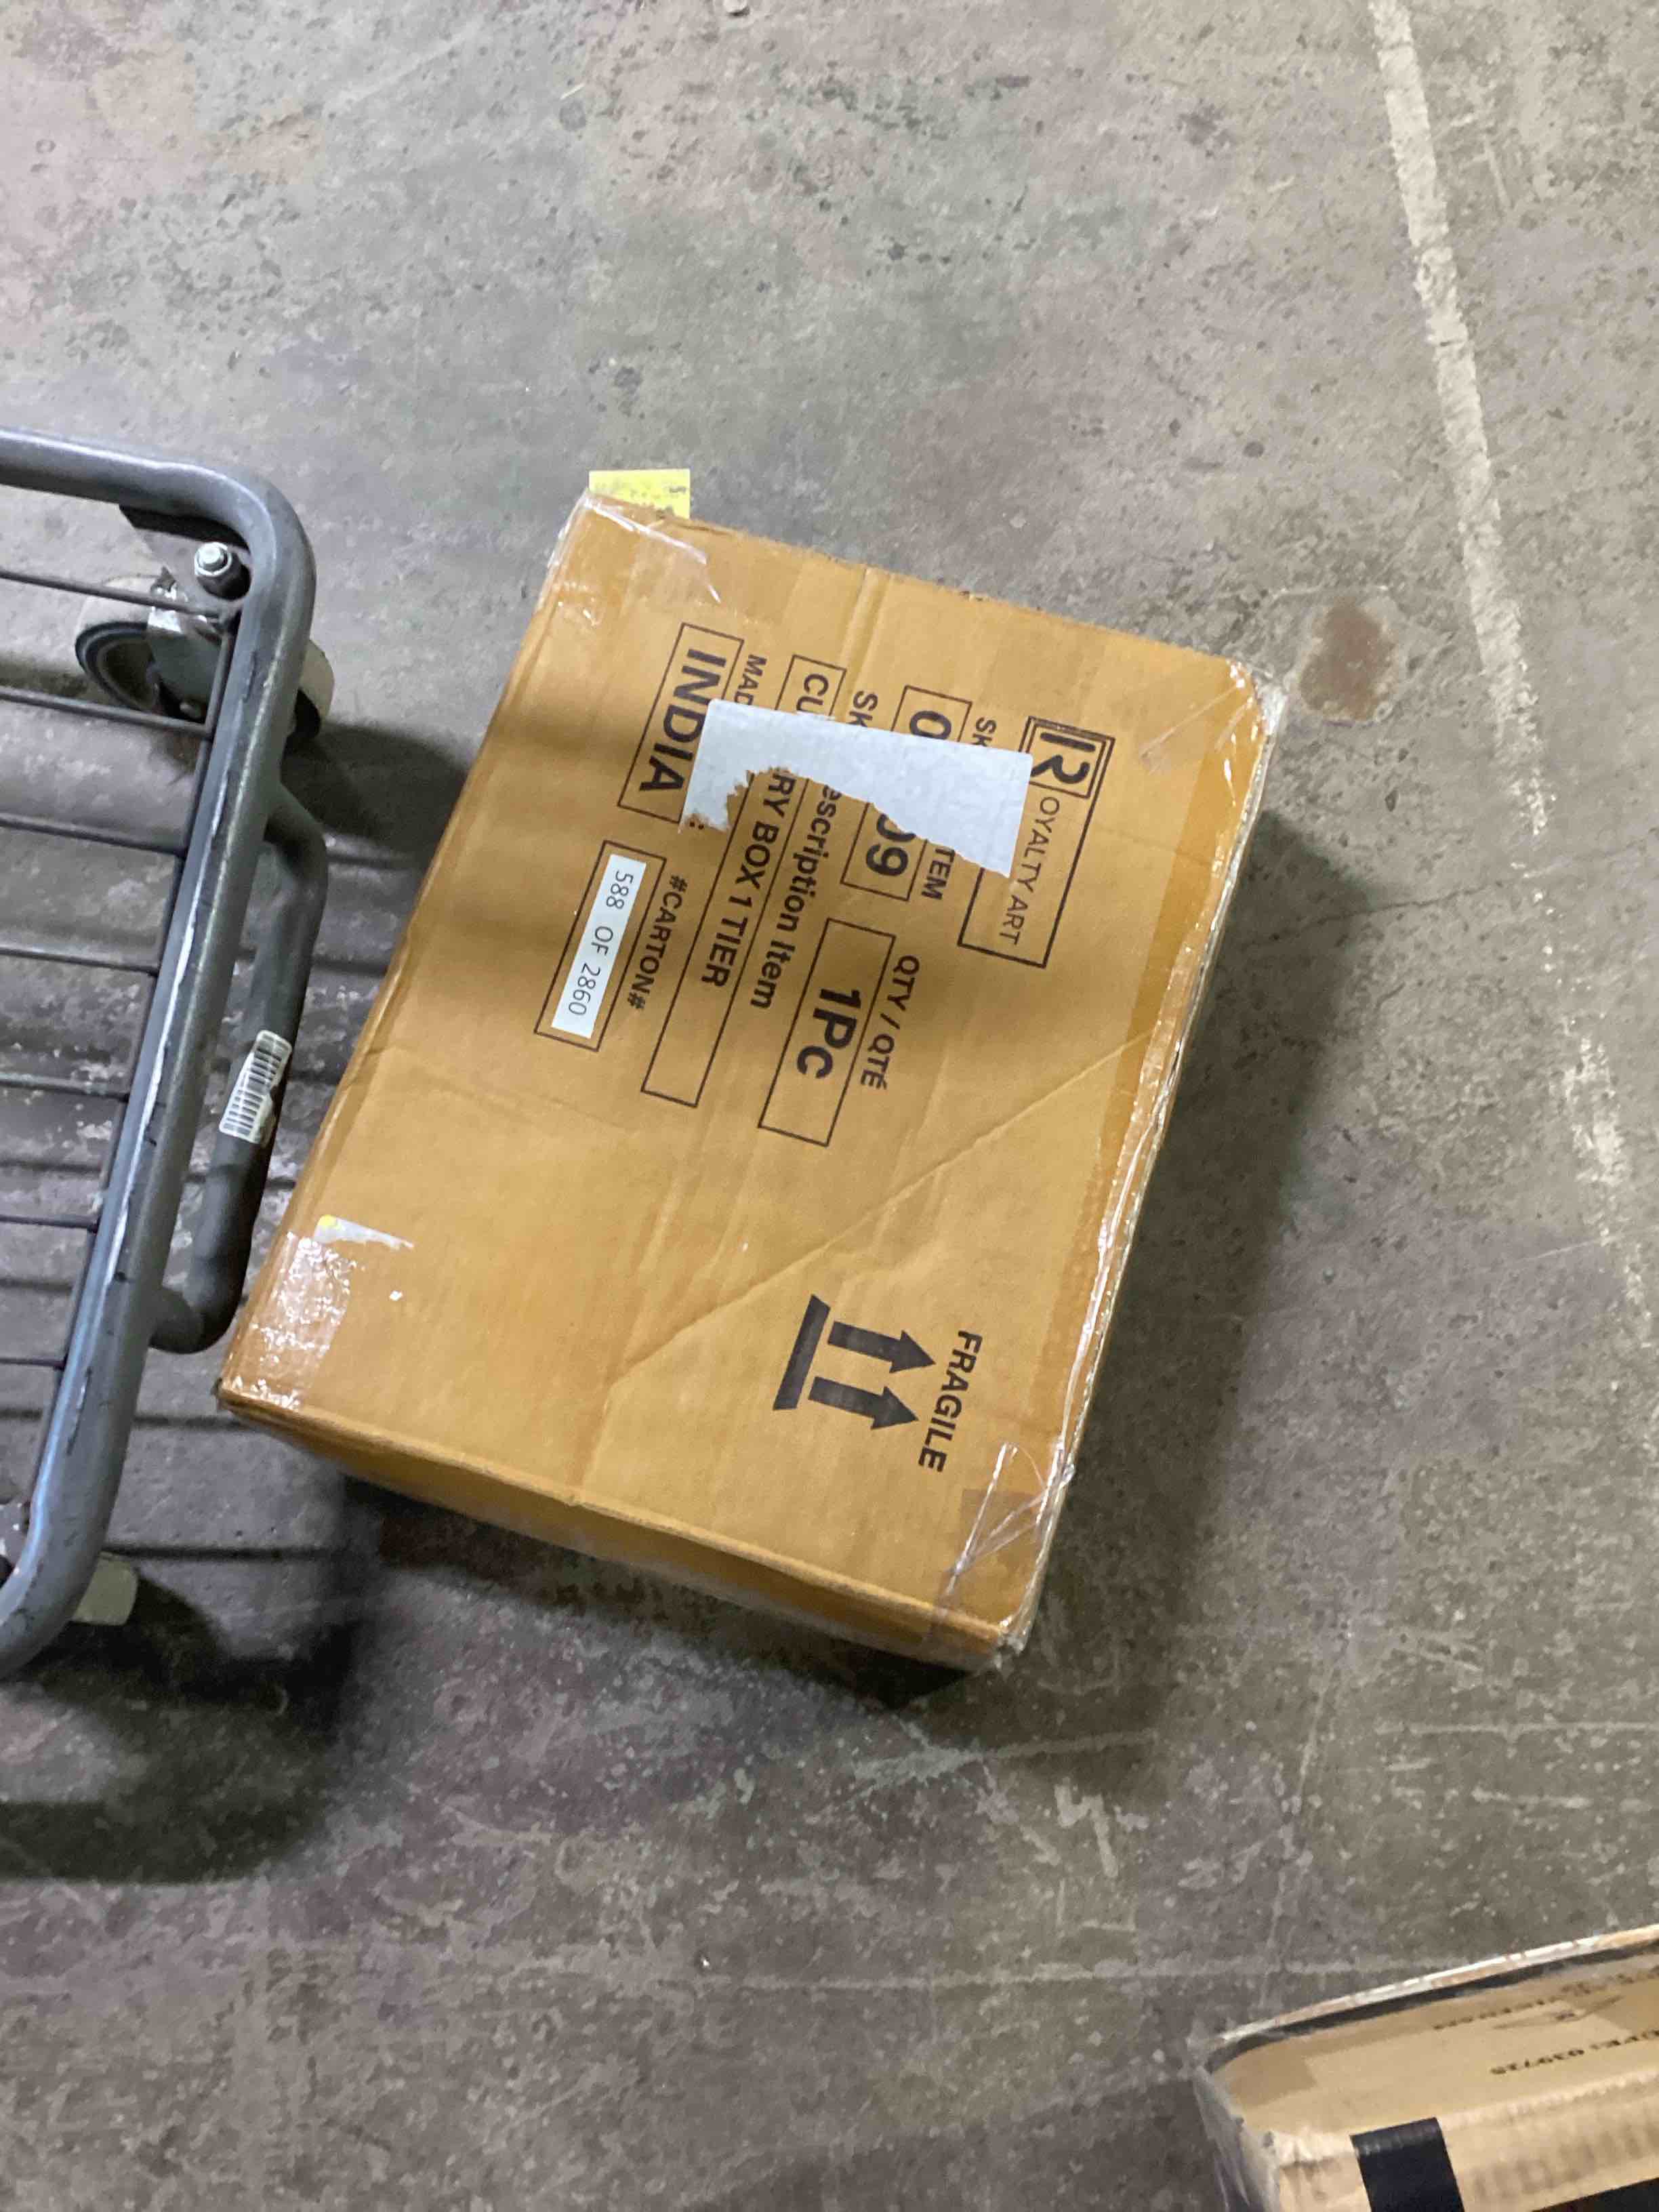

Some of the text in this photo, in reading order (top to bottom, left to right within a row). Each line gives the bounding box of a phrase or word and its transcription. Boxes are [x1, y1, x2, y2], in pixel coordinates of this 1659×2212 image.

[639, 648, 727, 792] INDIA
[734, 654, 767, 705] MAD
[736, 821, 780, 890] BOX
[750, 690, 878, 1009] SK escription Item
[921, 716, 998, 900] SK TEM
[568, 869, 634, 1016] 588 OF 2860
[627, 874, 689, 1010] #CARTON#
[701, 912, 748, 988] TIER
[728, 894, 753, 909] 1
[999, 895, 1029, 945] ART
[886, 954, 920, 1011] QTY
[918, 1330, 983, 1473] FRAGILE
